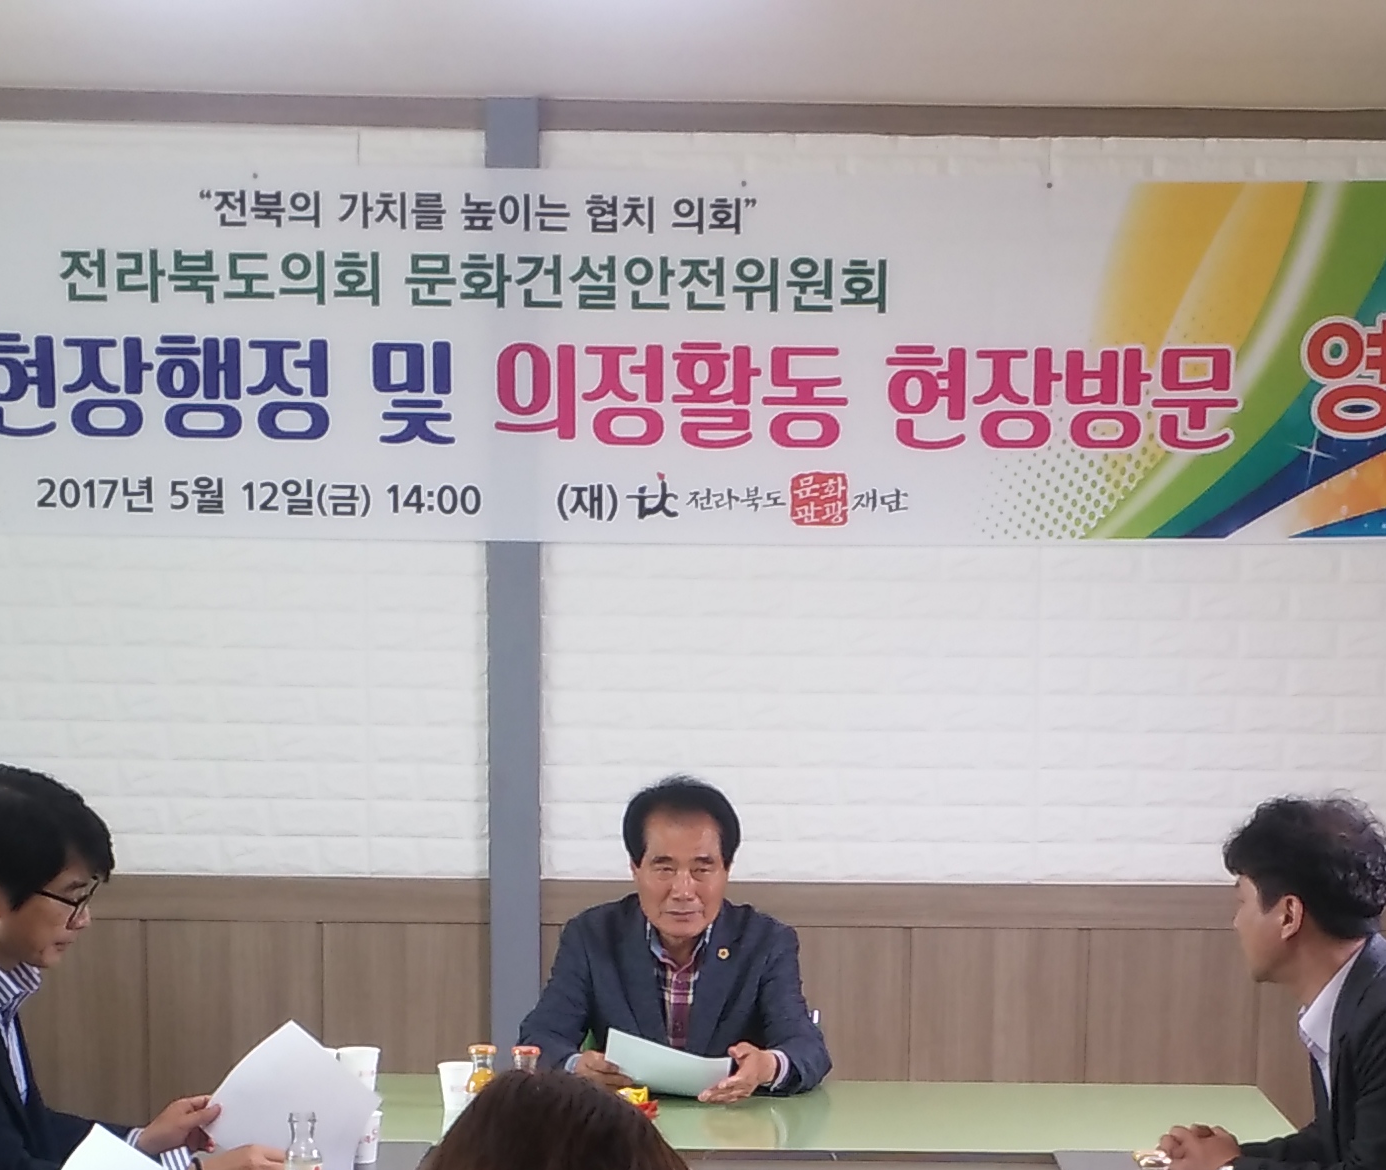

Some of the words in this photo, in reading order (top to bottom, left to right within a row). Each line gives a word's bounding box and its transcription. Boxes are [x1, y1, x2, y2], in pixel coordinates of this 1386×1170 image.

[337, 191, 447, 231] 가치를
[460, 192, 571, 232] 높이는
[585, 194, 655, 234] 협치
[59, 248, 380, 306] 전라북도의회
[404, 252, 888, 314] 문화건설안전위원회
[371, 340, 457, 445] 및
[494, 341, 849, 448] 의정활동
[886, 345, 1239, 450] 현장방문
[36, 476, 154, 513] 2017년
[170, 477, 225, 515] 5월
[242, 478, 371, 518] 12일(금)
[386, 484, 482, 516] 14:00
[556, 483, 618, 522] (재)
[686, 486, 787, 511] 전라북도
[851, 486, 909, 515] 재단
